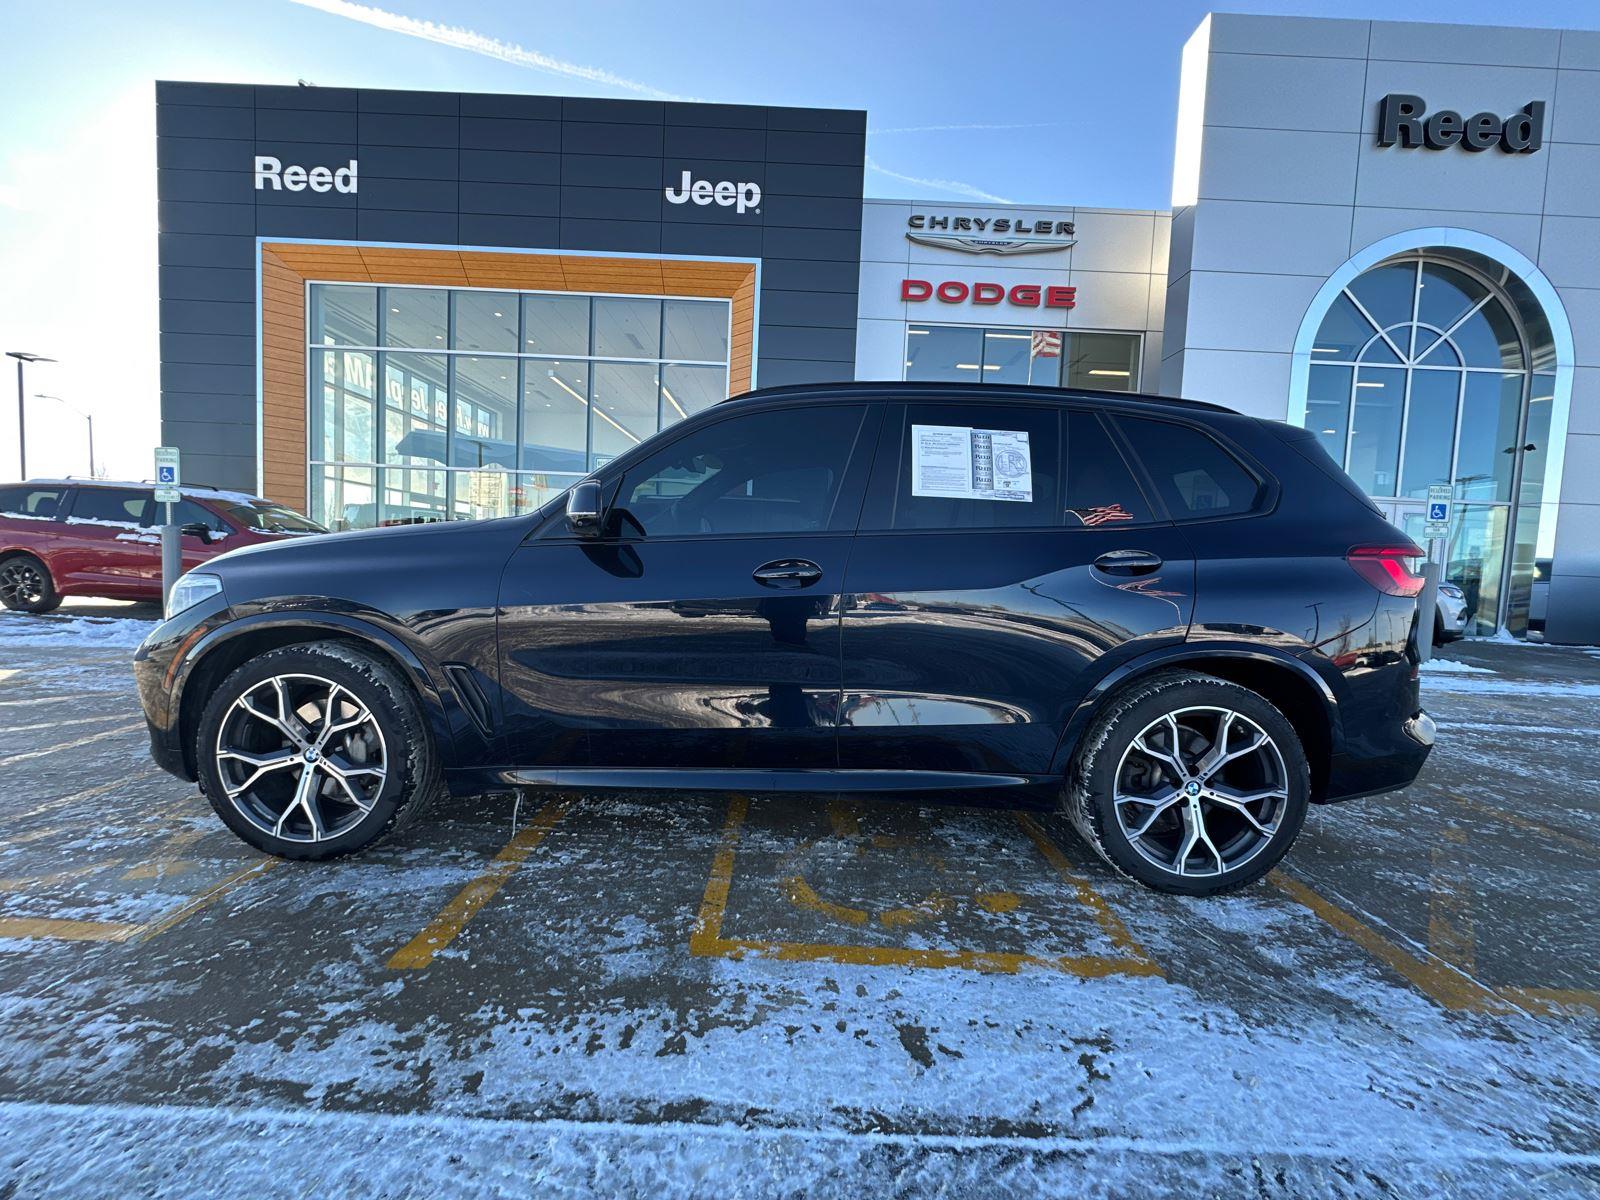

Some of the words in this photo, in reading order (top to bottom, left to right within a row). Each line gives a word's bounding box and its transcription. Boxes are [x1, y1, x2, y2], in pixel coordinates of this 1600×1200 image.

[1377, 94, 1546, 154] Reed
[255, 155, 358, 194] Reed
[665, 170, 761, 214] Jeep
[908, 214, 1076, 235] CHRYSLER
[901, 279, 1077, 309] DODGE
